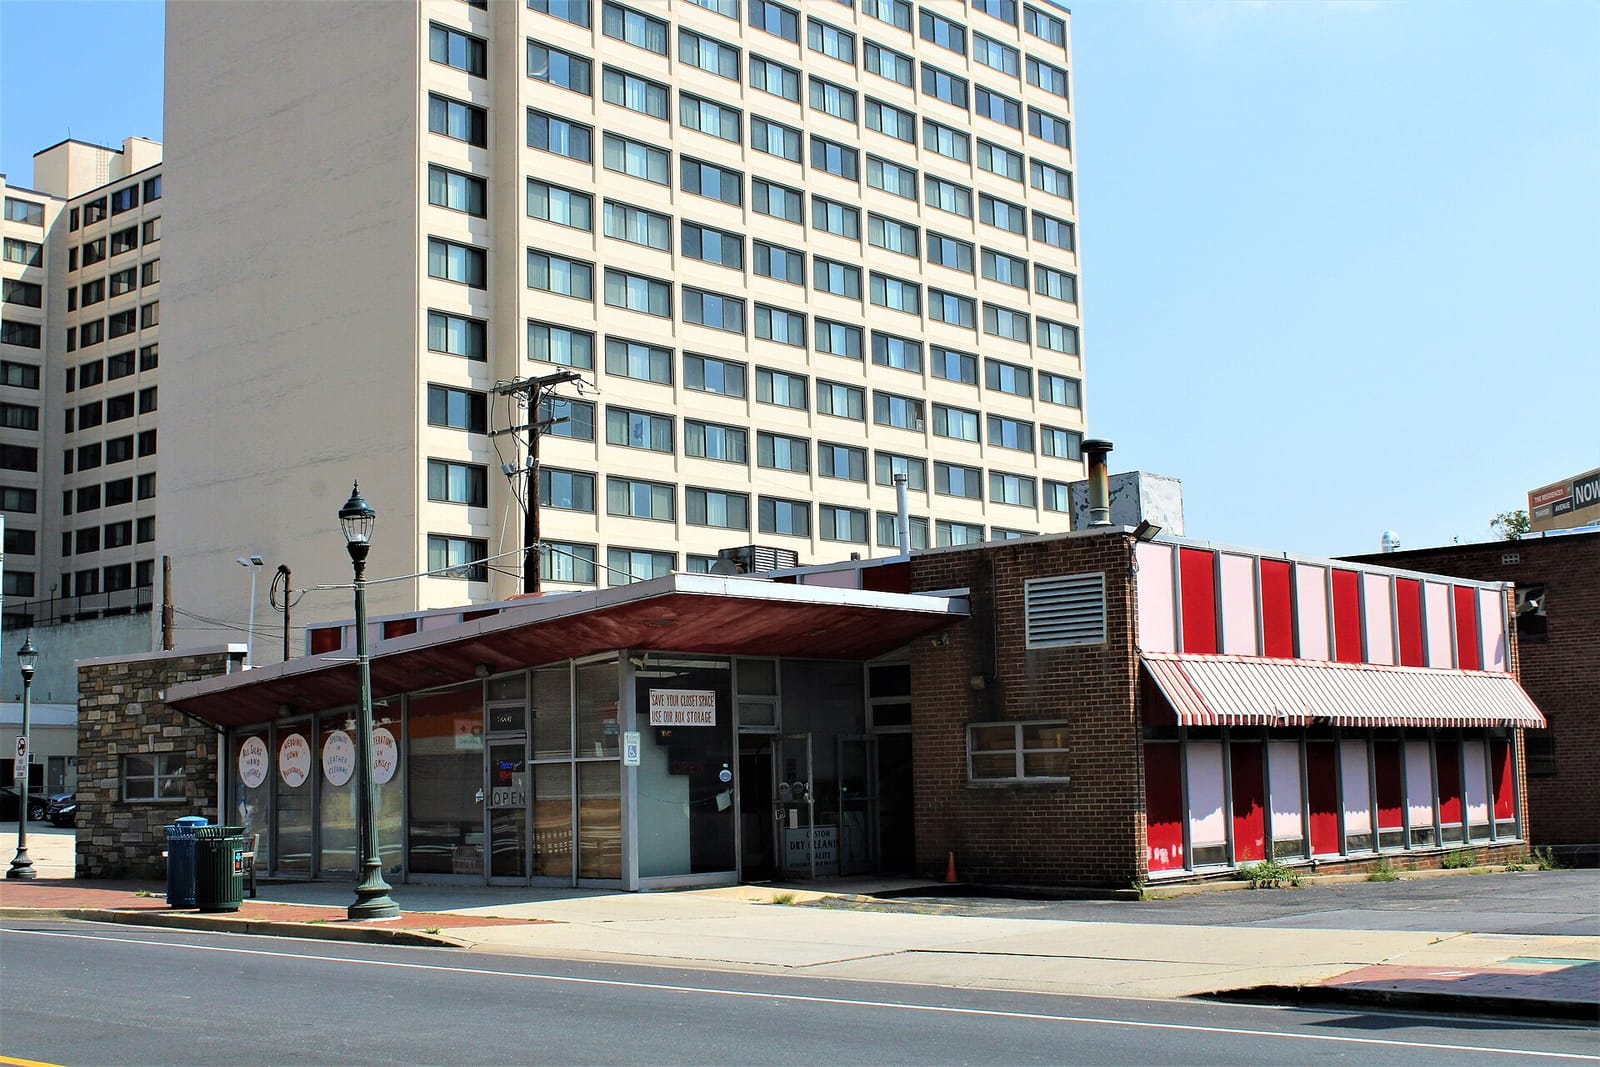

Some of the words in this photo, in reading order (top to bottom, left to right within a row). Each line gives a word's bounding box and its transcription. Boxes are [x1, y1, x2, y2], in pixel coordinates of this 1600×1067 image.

[1575, 480, 1600, 504] NOW
[1555, 501, 1570, 512] AVENUE
[651, 694, 664, 706] SAVE
[667, 694, 679, 706] YOUR
[680, 695, 698, 707] CLOSET
[699, 695, 714, 707] SPACE
[651, 710, 662, 722] USE
[663, 710, 673, 722] OUR
[675, 711, 685, 723] BOX
[686, 711, 712, 723] STORAGE
[283, 738, 303, 749] WEDDING
[287, 751, 299, 760] GOWN
[328, 755, 347, 765] LEATHER
[328, 765, 348, 775] CLEANING
[493, 792, 526, 805] OPEN
[806, 830, 831, 838] CSTOM
[790, 840, 805, 850] DRY
[806, 851, 831, 861] QALITY
